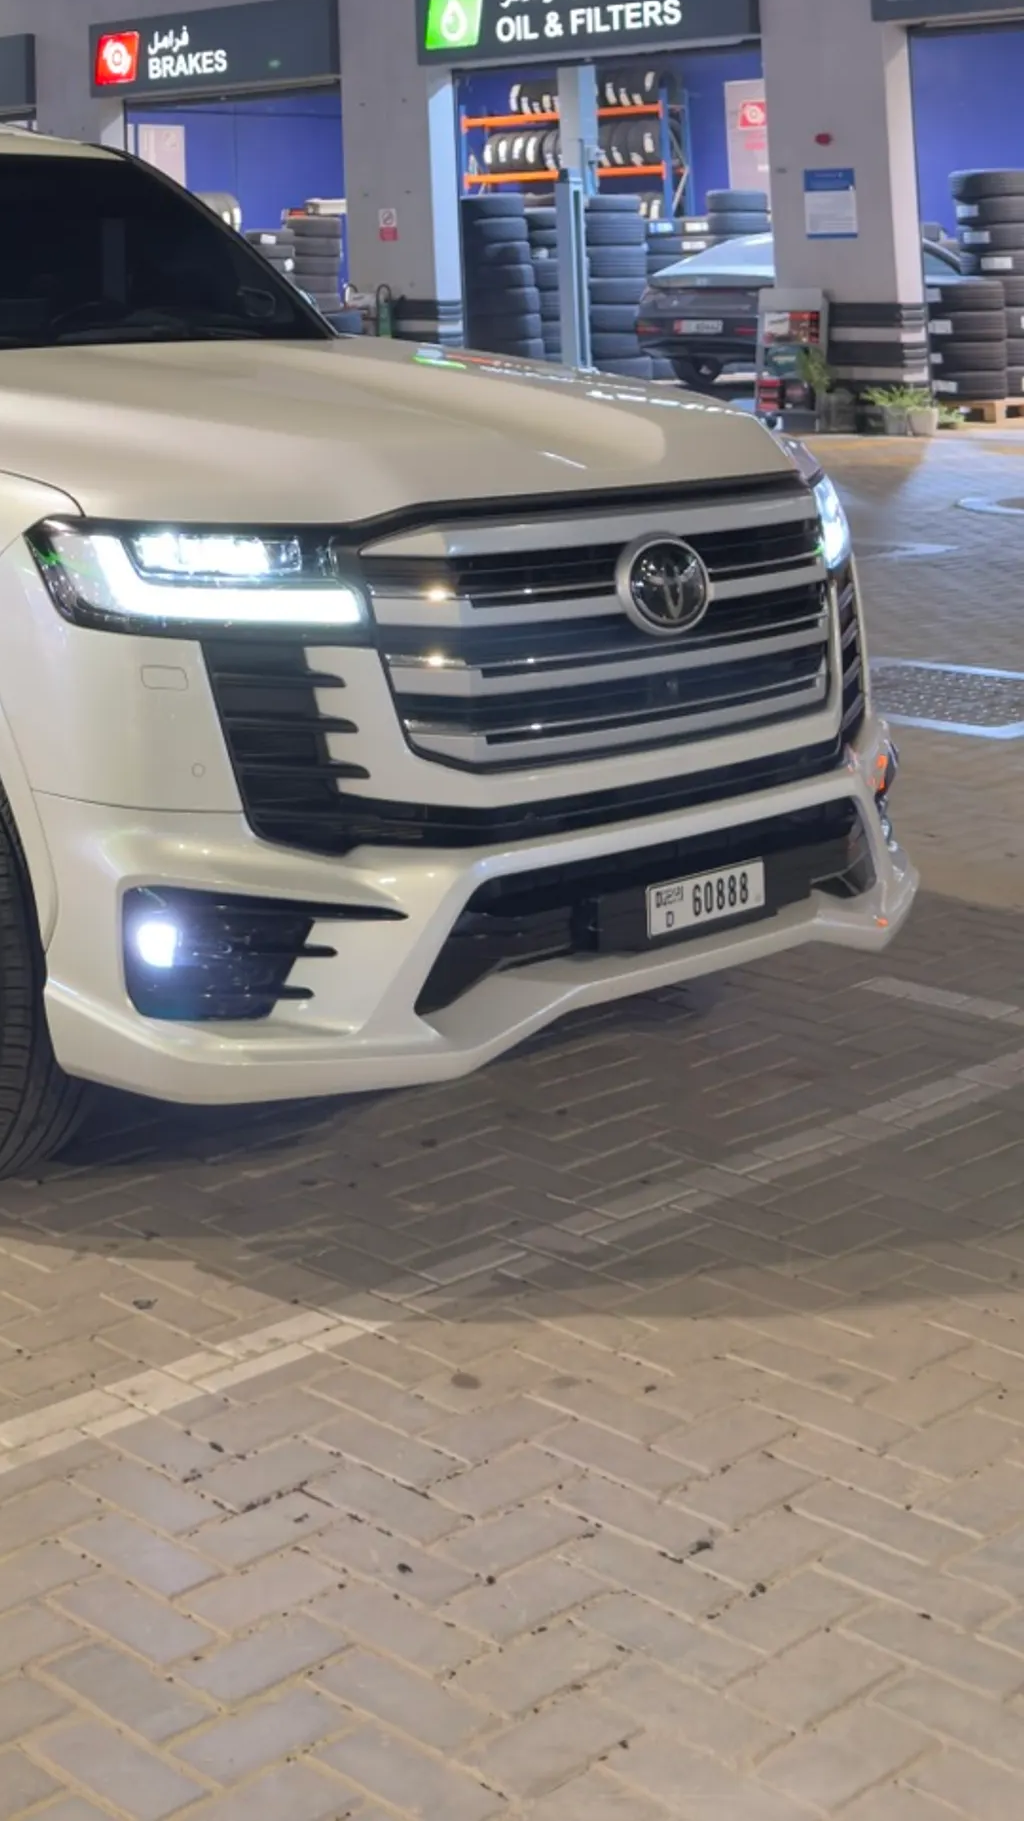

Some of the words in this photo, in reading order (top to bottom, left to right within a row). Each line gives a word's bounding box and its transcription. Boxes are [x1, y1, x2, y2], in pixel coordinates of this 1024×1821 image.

[147, 24, 190, 56] فرامل
[495, 14, 540, 43] OIL
[543, 11, 564, 38] &
[147, 48, 228, 80] BRAKES
[691, 871, 750, 917] 60888
